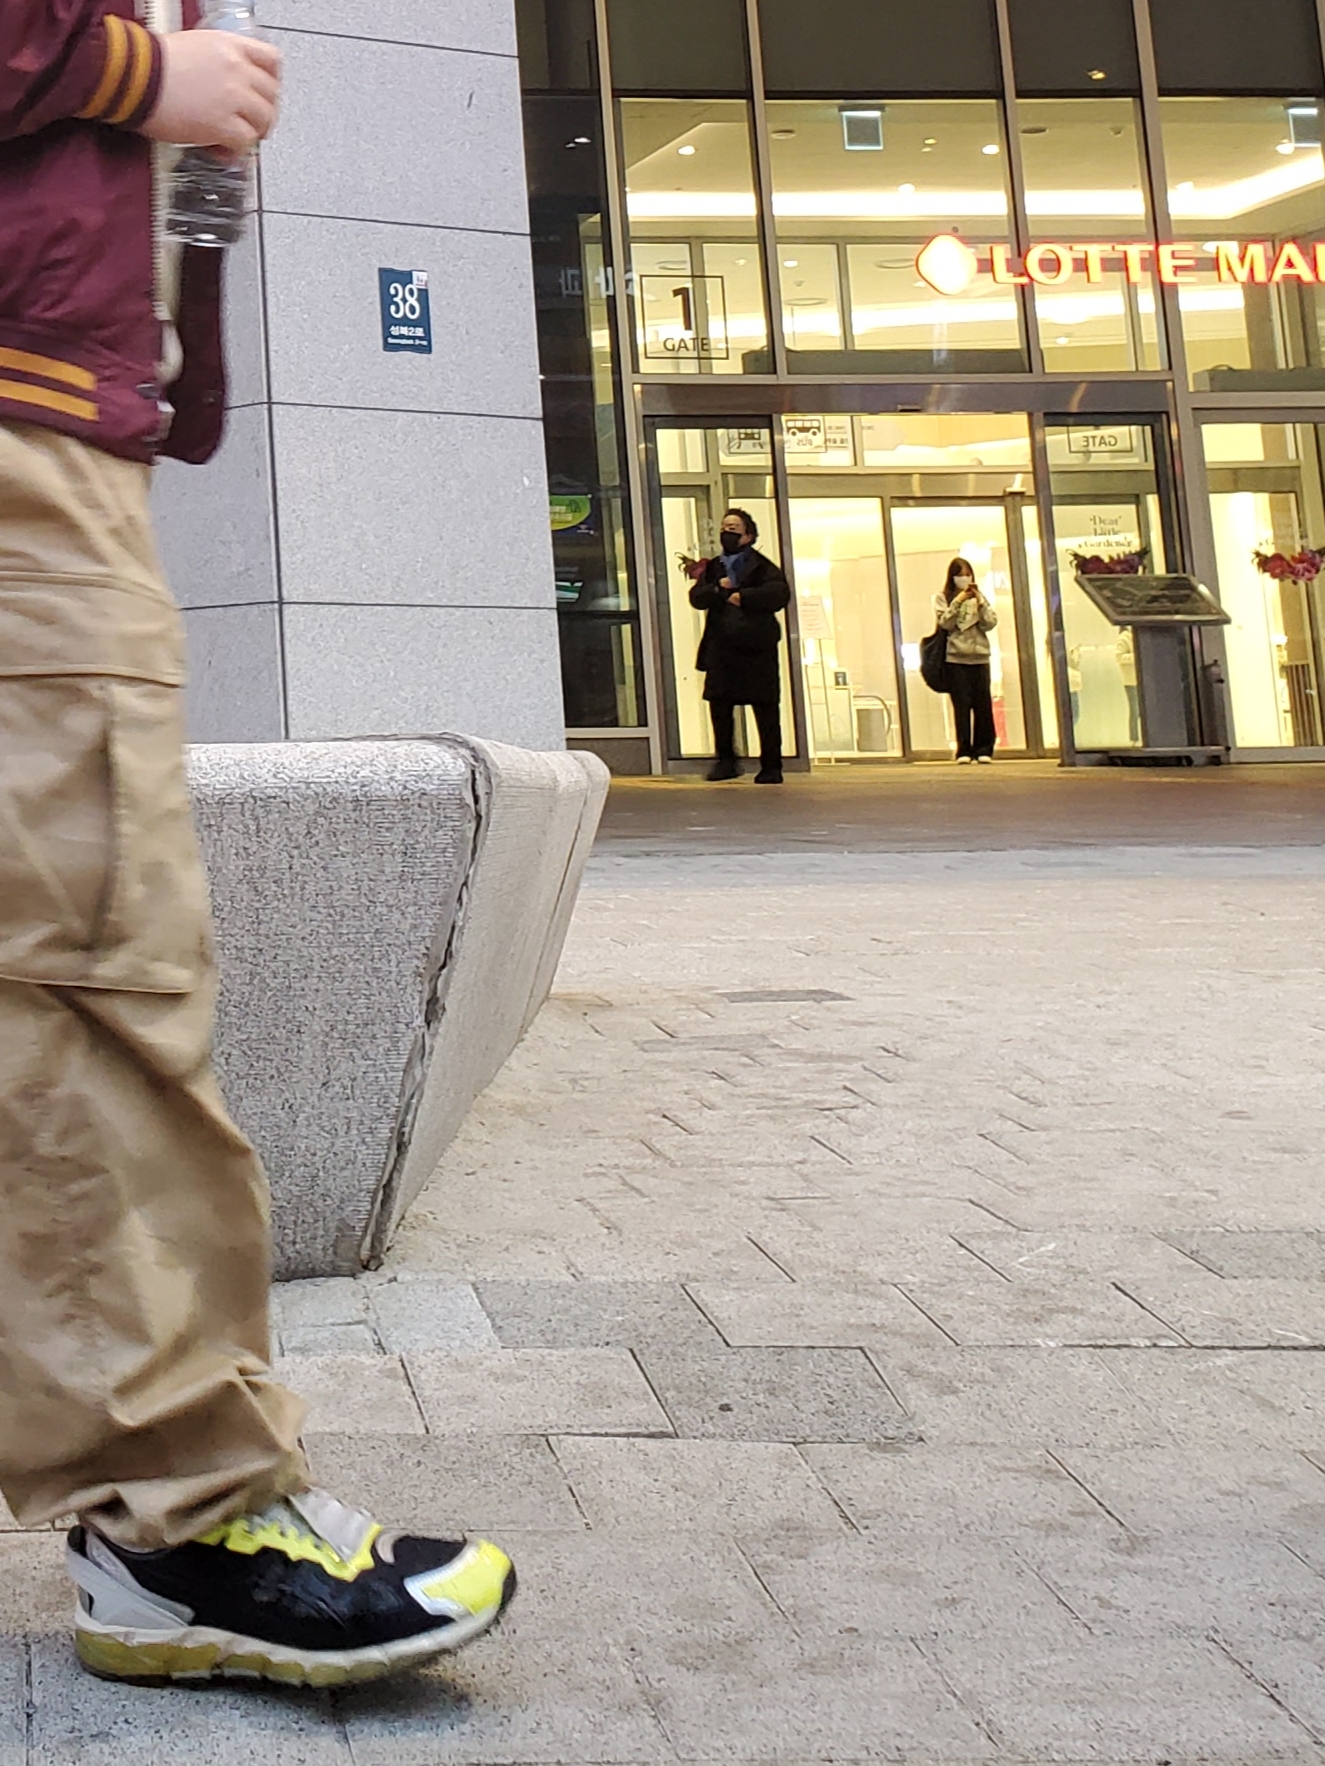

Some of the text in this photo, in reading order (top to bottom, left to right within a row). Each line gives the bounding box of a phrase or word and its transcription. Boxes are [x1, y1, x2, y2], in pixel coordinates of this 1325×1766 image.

[990, 239, 1325, 285] LOTTE MA
[389, 282, 420, 319] 38
[671, 285, 693, 331] 1
[662, 336, 711, 352] GATE
